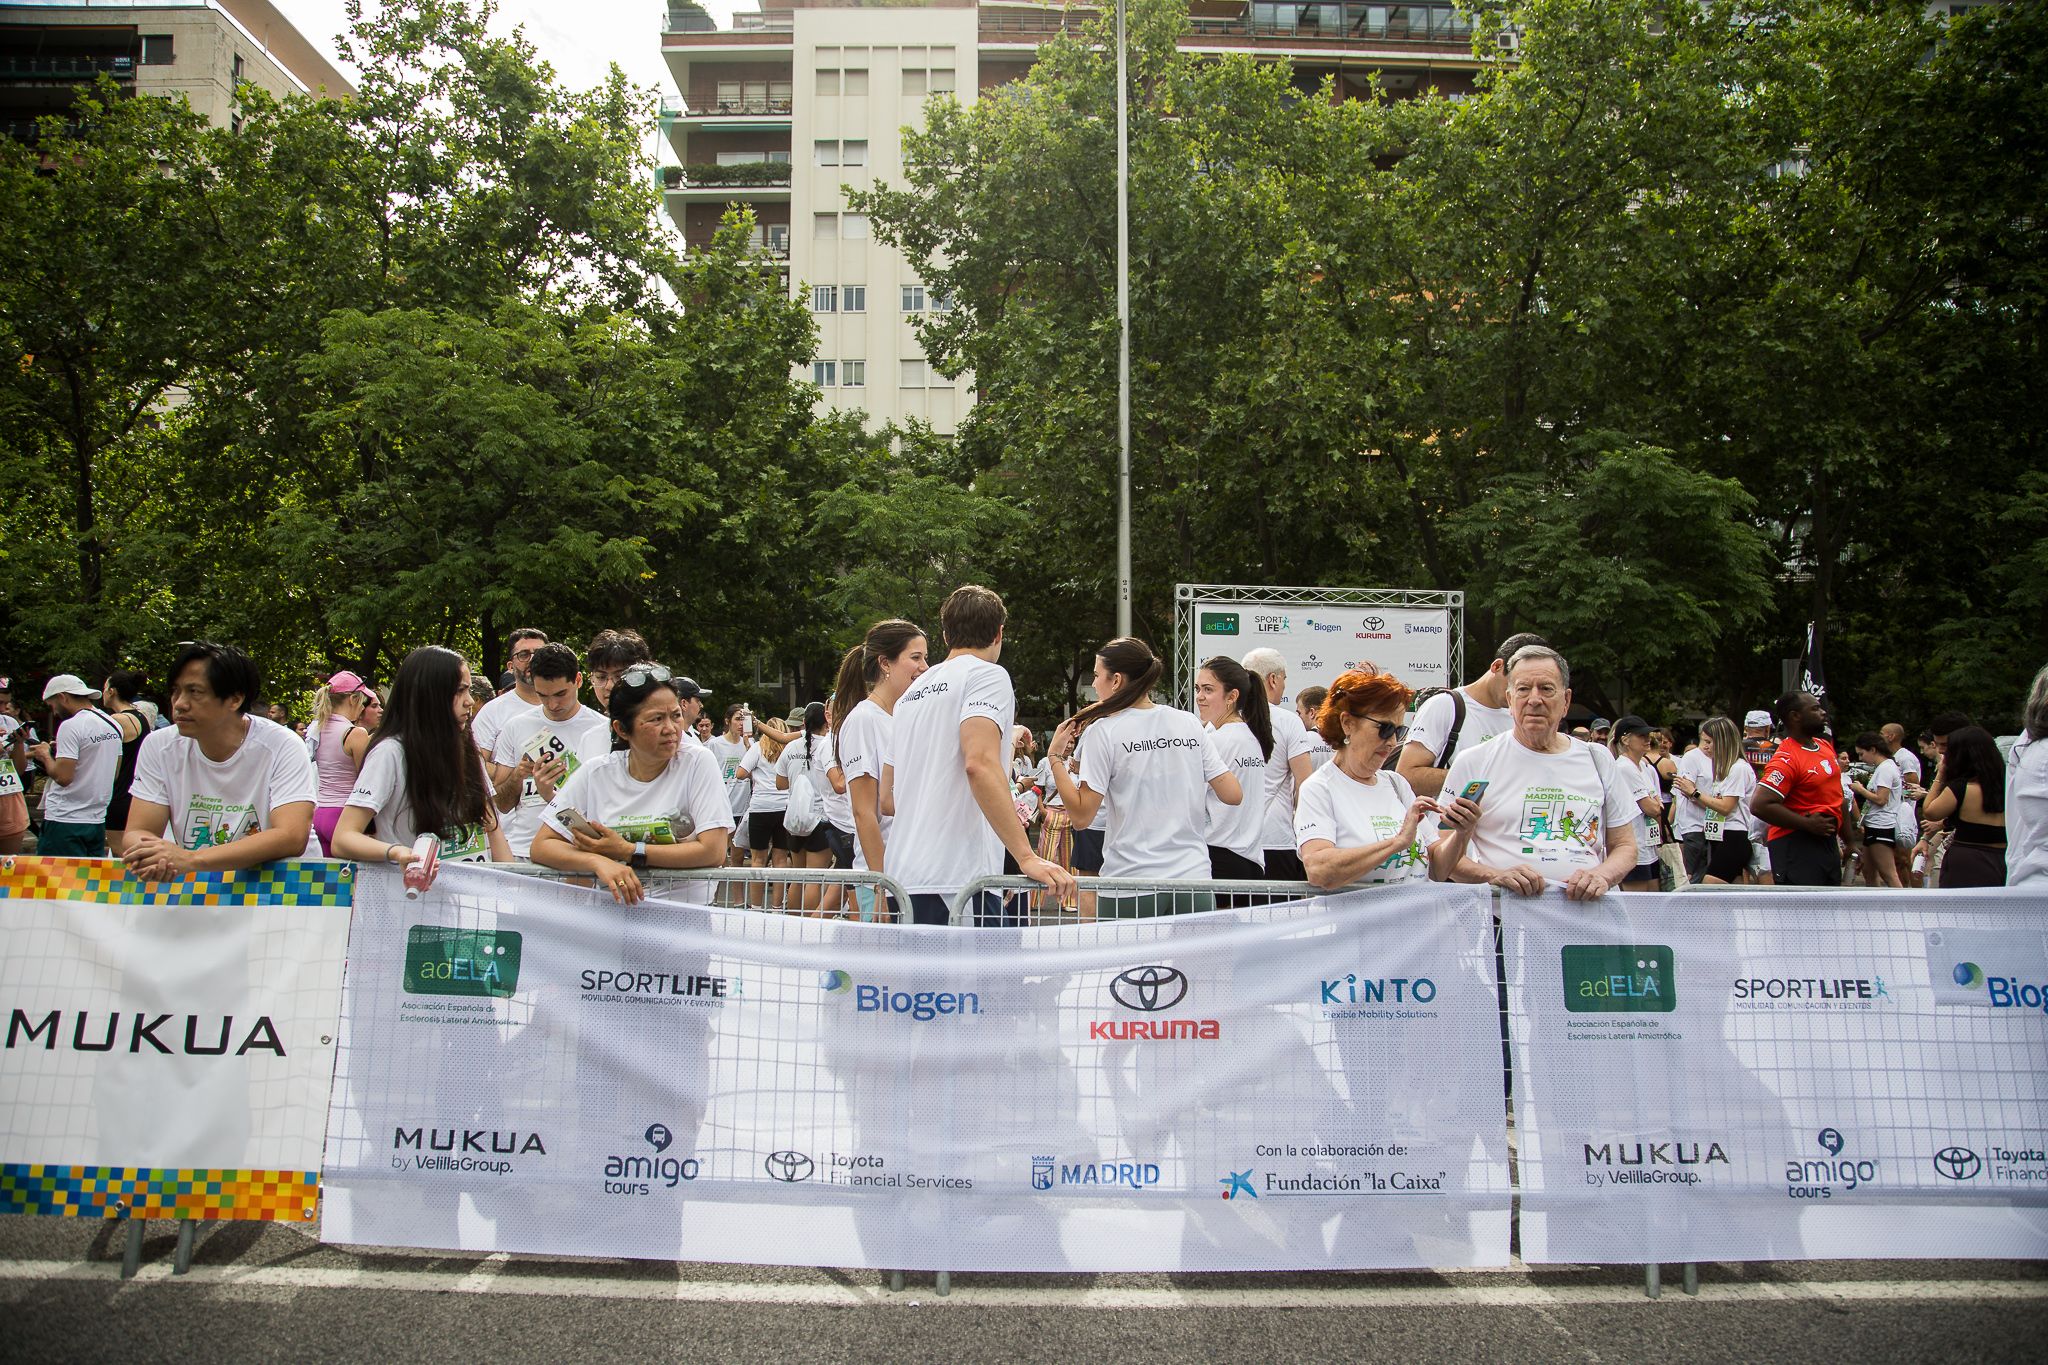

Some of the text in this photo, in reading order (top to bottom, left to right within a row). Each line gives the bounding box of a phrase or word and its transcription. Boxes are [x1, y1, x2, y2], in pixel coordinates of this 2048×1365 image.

[1205, 621, 1234, 631] adELA
[1254, 615, 1283, 624] SPORT
[1258, 624, 1280, 632] LIFE
[1314, 622, 1342, 633] Biogen
[1412, 625, 1443, 635] MADRID
[1301, 661, 1322, 669] amigo
[1567, 794, 1586, 802] CON
[1704, 822, 1719, 833] 858
[420, 957, 500, 982] adELA
[581, 969, 727, 998] SPORTLIFE
[1579, 975, 1660, 997] adELA
[1734, 978, 1872, 999] SPORTLIFE
[401, 1001, 496, 1013] Asociación Española de
[690, 1000, 726, 1009] EVENTOS
[1839, 1002, 1872, 1010] EVENTOS
[400, 1013, 440, 1024] Esclerosis
[442, 1016, 469, 1025] Lateral
[1322, 1010, 1438, 1020] Flexible Mobility Solutions
[1567, 1020, 1659, 1030] Asociación Española de
[5, 1008, 287, 1057] MUKUA
[1567, 1032, 1682, 1041] Esclerosis Lateral Amiotrófica
[394, 1127, 547, 1155] MUKUA
[1256, 1143, 1408, 1157] Con la colaboración de:
[1584, 1142, 1730, 1165] MUKUA
[1992, 1147, 2045, 1164] Toyota
[391, 1154, 514, 1176] by VelillaGroup.
[830, 1152, 884, 1170] Toyota
[830, 1170, 973, 1190] Financial Services
[1060, 1163, 1160, 1189] MADRID
[1265, 1172, 1360, 1191] Fundación
[1585, 1169, 1701, 1187] by VelillaGroup.
[604, 1179, 649, 1195] tours
[1788, 1184, 1831, 1198] tours
